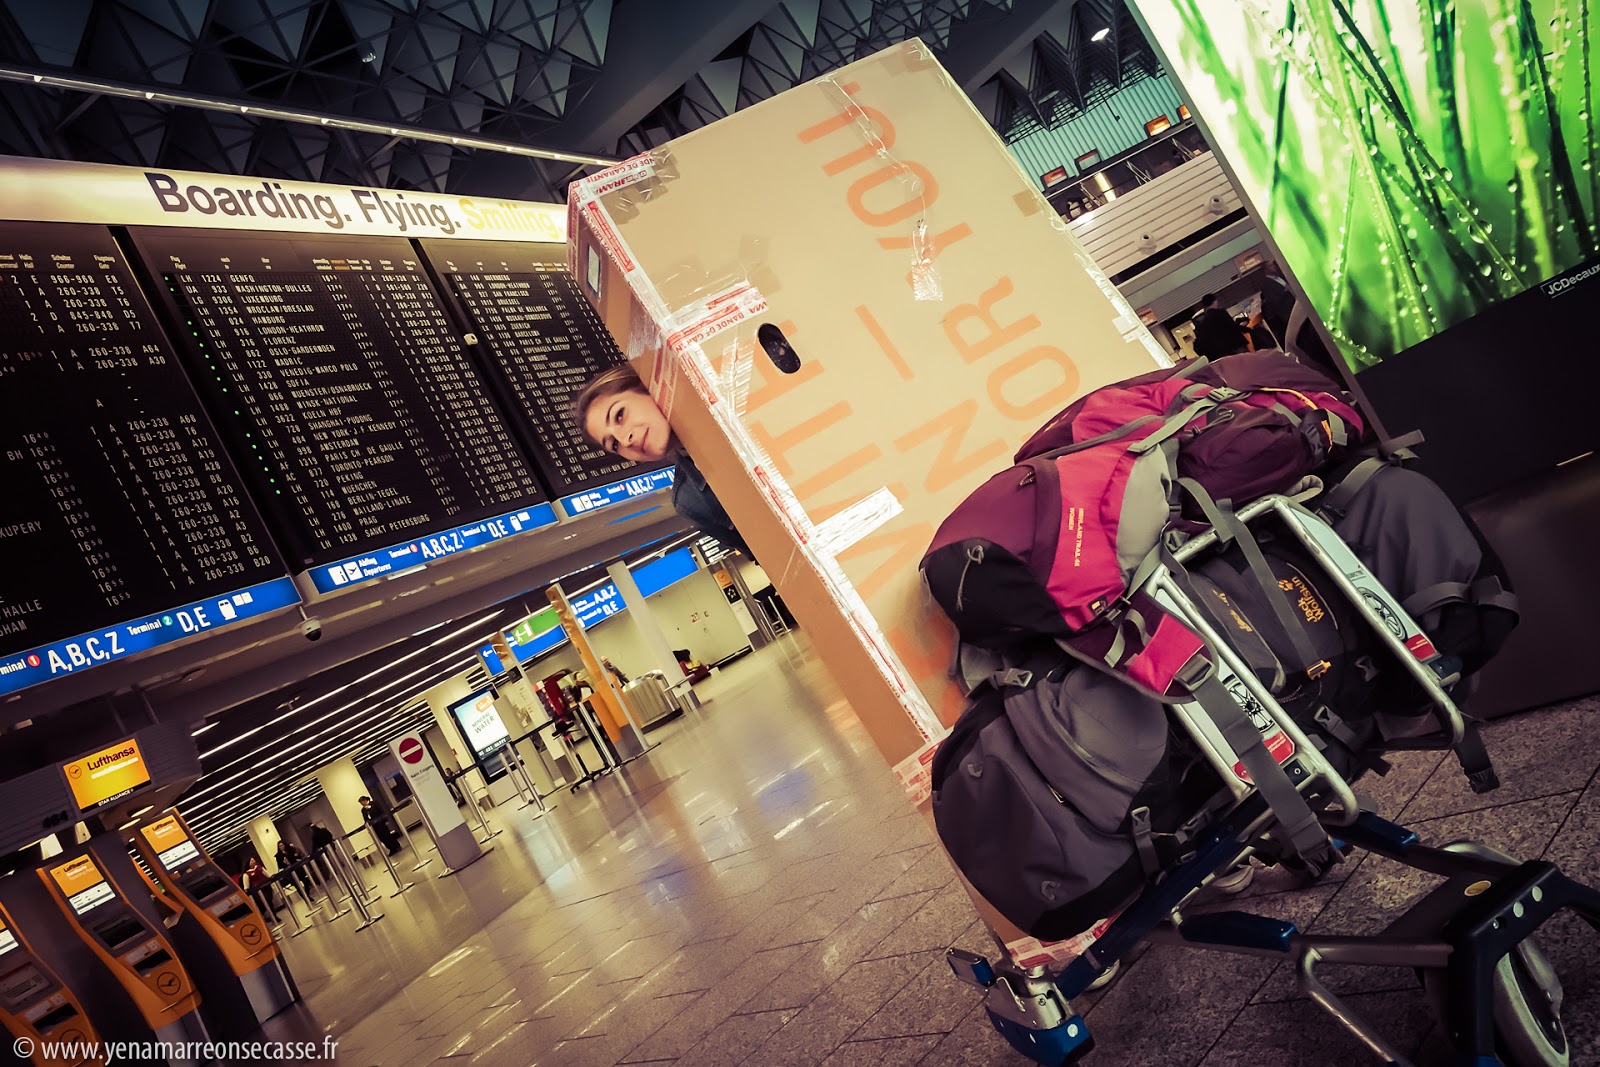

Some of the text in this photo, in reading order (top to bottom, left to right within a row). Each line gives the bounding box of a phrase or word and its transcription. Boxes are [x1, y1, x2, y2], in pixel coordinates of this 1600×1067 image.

[144, 172, 563, 239] Boarding. Flying. Smiling.
[50, 274, 95, 284] 966-968
[1548, 264, 1600, 295] JCDecaux
[56, 286, 101, 296] 260-338
[63, 298, 108, 308] 260-338
[69, 310, 114, 320] 845-848
[76, 322, 119, 332] 260-338
[88, 346, 132, 357] 260-338
[95, 357, 138, 369] 260-338
[127, 417, 169, 431] 260-338
[133, 429, 176, 443] 260-338
[139, 441, 182, 456] 260-338
[146, 453, 188, 468] 260-338
[152, 465, 194, 480] 260-338
[159, 477, 201, 493] 260-338
[165, 489, 207, 505] 260-338
[171, 502, 213, 518] 260-338
[178, 513, 220, 531] 260-338
[184, 526, 226, 543] 260-338
[191, 538, 232, 556] 260-338
[197, 550, 239, 568] 260-338
[204, 562, 245, 581] 260-338
[1292, 576, 1324, 620] Wolfskin
[2, 599, 42, 618] HALLE
[1298, 597, 1318, 622] Jack
[127, 619, 162, 636] Terminal
[176, 606, 212, 634] D,E
[474, 716, 495, 734] WATER
[87, 746, 136, 771] Lufthansa
[98, 798, 110, 807] STAR
[63, 858, 89, 873] Lufthansa
